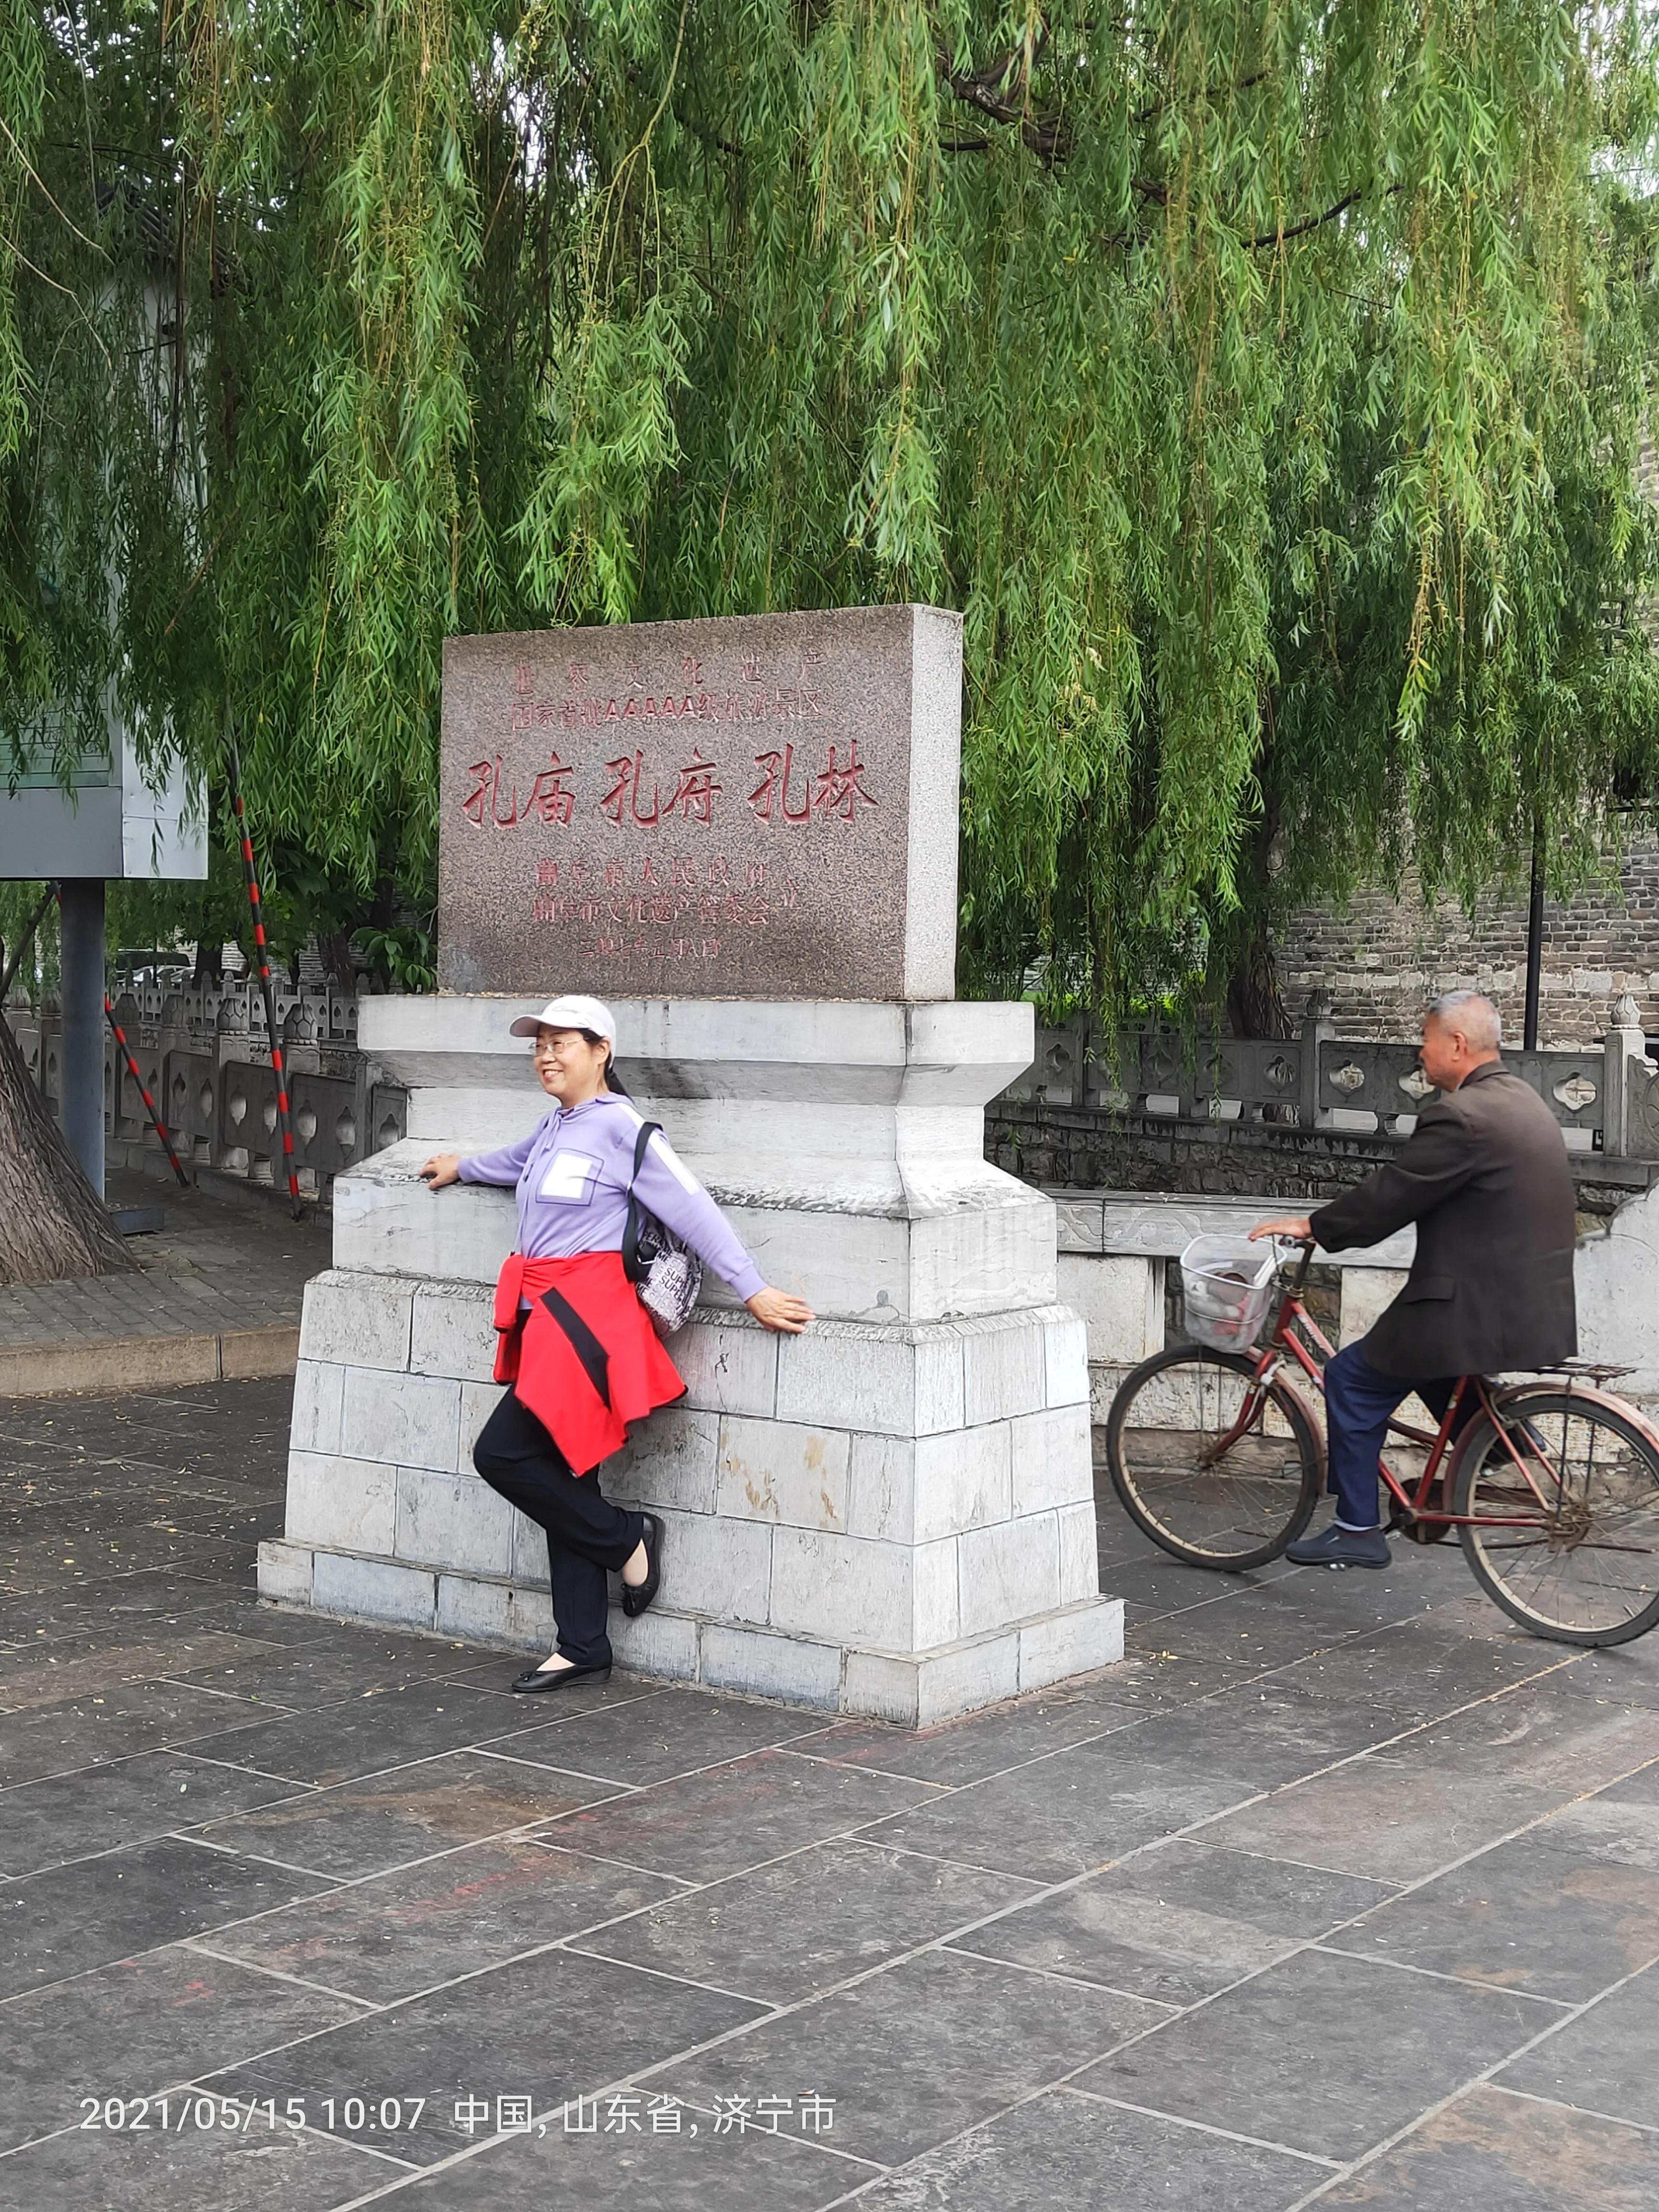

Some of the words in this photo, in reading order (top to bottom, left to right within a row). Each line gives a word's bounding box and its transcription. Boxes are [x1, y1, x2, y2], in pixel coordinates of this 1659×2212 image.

[516, 649, 826, 695] 世界文化遗产
[462, 751, 576, 830] 孔庙
[601, 749, 723, 827] 孔府
[747, 739, 879, 824] 孔林
[536, 856, 768, 888] 曲阜市人民政府
[533, 893, 769, 925] 曲阜市文化遗产管委会
